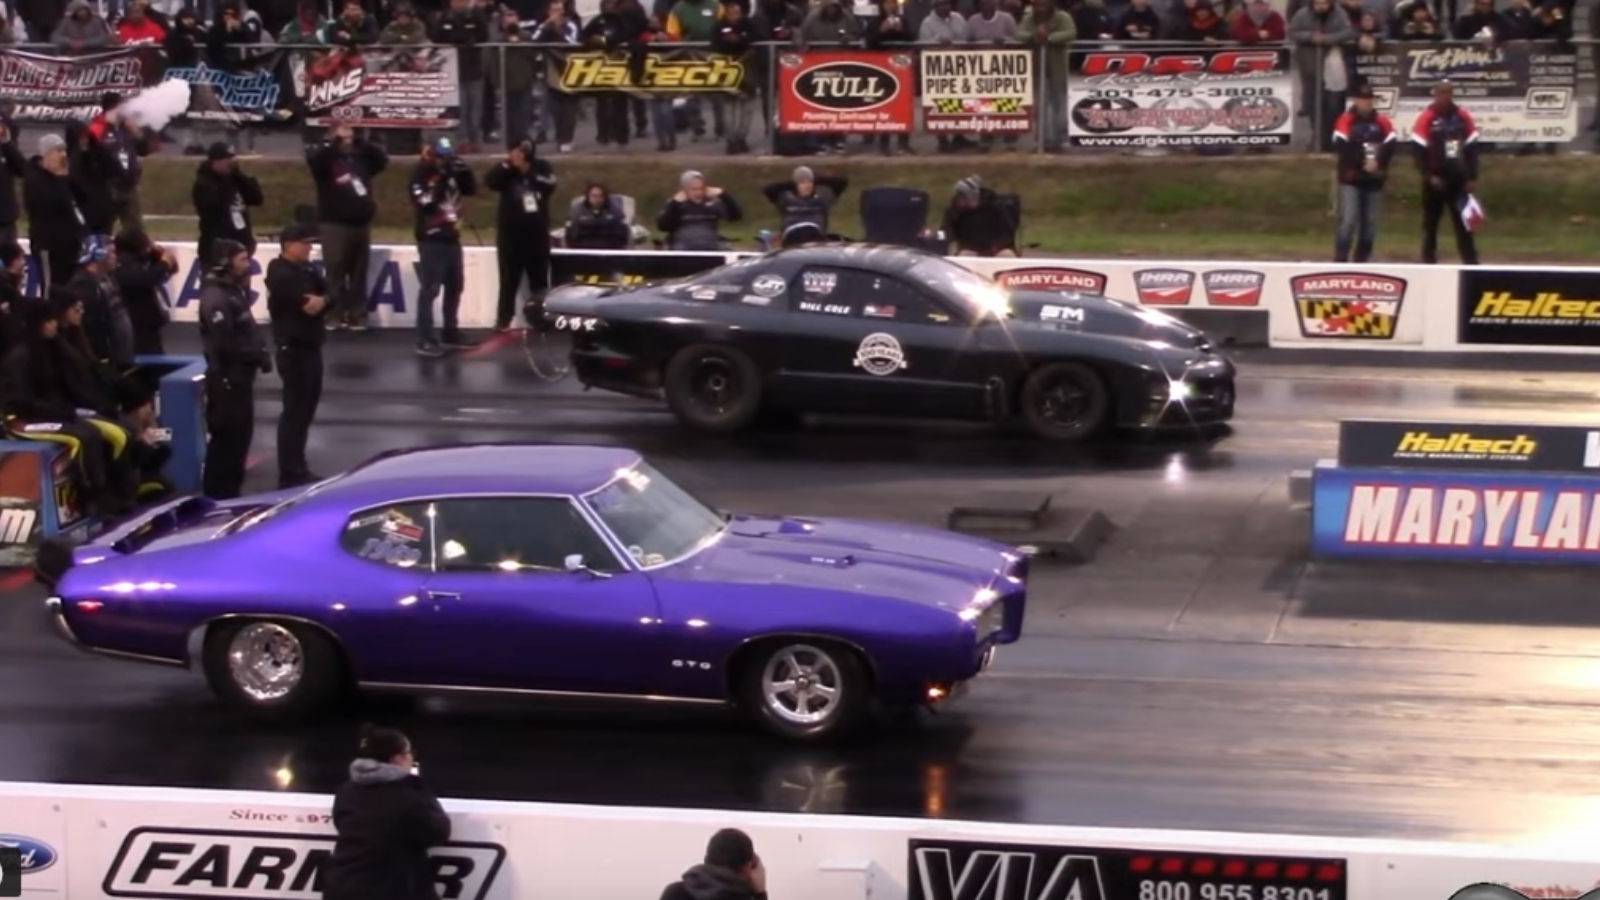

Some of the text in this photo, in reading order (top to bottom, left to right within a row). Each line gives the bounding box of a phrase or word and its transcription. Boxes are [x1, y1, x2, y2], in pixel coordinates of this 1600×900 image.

[926, 54, 1028, 76] MARYLAND
[309, 67, 363, 105] WMS
[812, 77, 884, 97] TULL
[927, 77, 1027, 94] PIPE & SUPPLY
[1088, 87, 1274, 98] 301-475-3808
[928, 116, 1029, 132] www.mdpipe.com
[1542, 126, 1566, 137] MD
[1079, 135, 1280, 147] www.dgkustom.com
[1007, 274, 1096, 288] MARYLAND
[1141, 272, 1189, 283] IHRA
[1210, 273, 1258, 284] IHRA
[1304, 279, 1395, 292] MARYLAND
[1397, 432, 1536, 455] Haltech
[672, 658, 711, 669] GTO
[229, 808, 288, 820] Since
[1139, 880, 1190, 900] 800
[1200, 883, 1253, 900] 955
